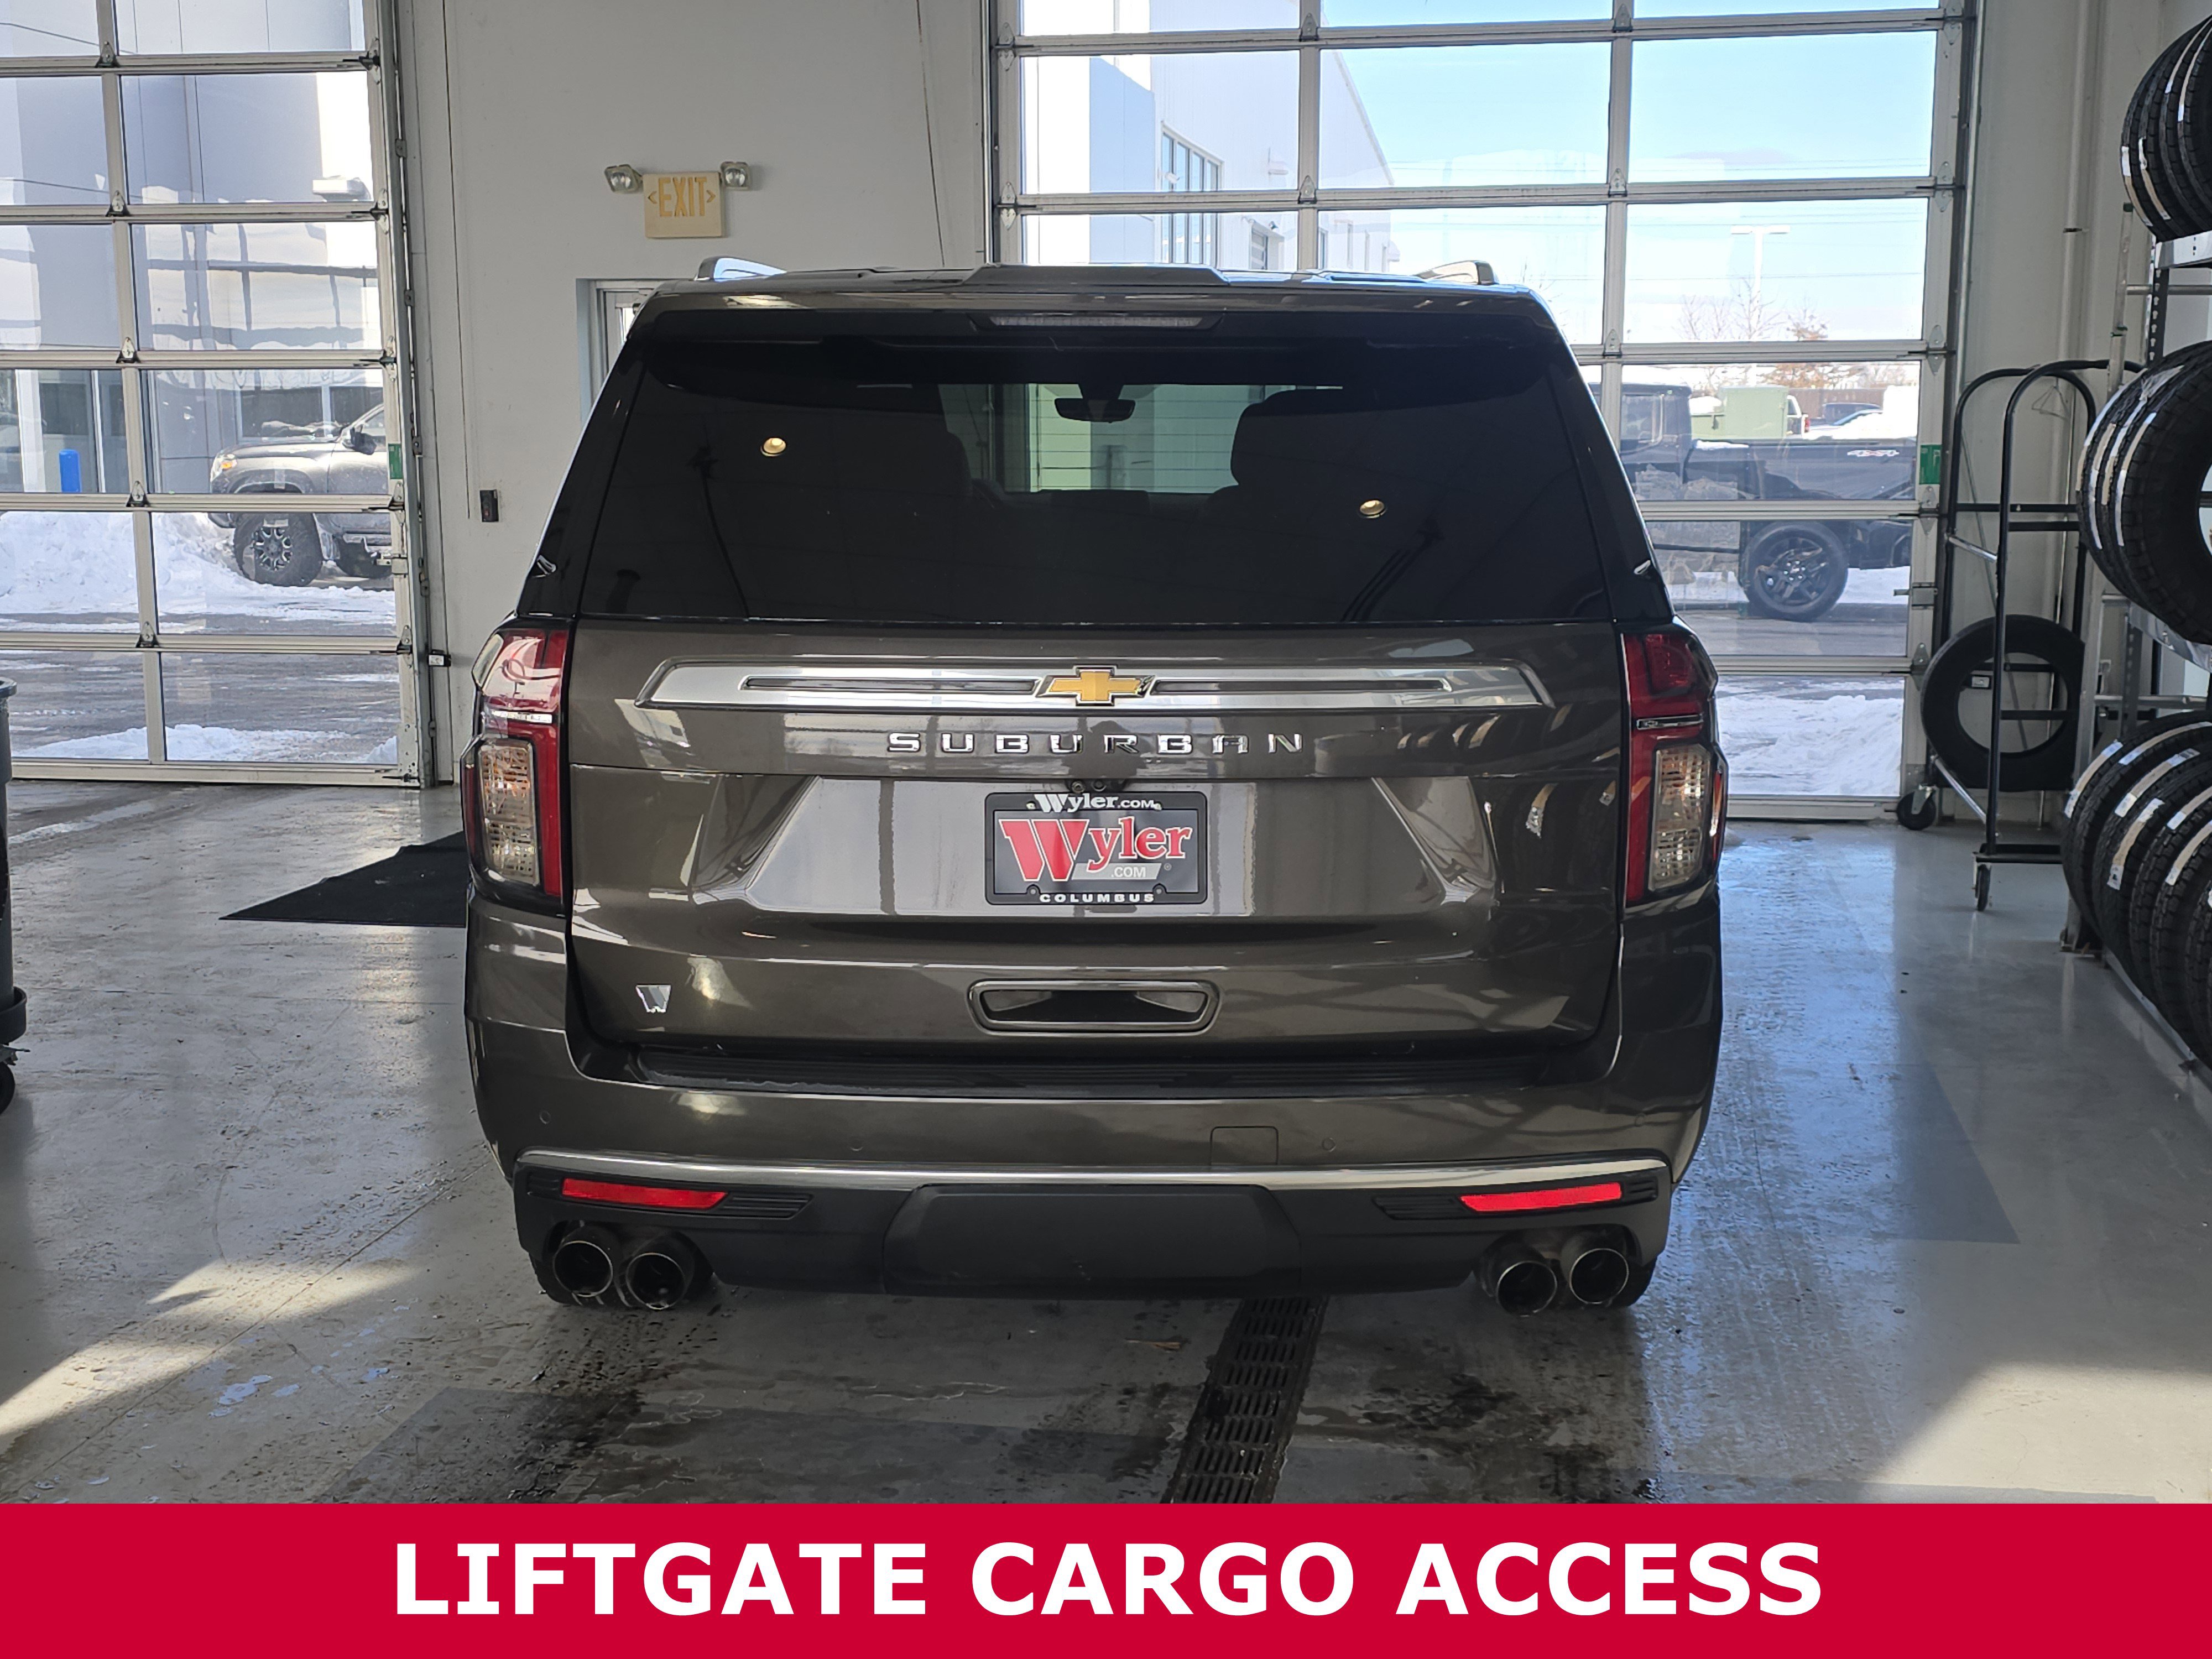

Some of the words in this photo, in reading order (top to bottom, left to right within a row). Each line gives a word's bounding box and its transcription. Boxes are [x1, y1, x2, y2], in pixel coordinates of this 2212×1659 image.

[658, 176, 707, 217] EXIT
[887, 733, 1302, 754] SUBURBAN
[998, 816, 1193, 881] Wyler
[1110, 867, 1146, 878] .COM
[1039, 894, 1155, 903] COLUMBUS
